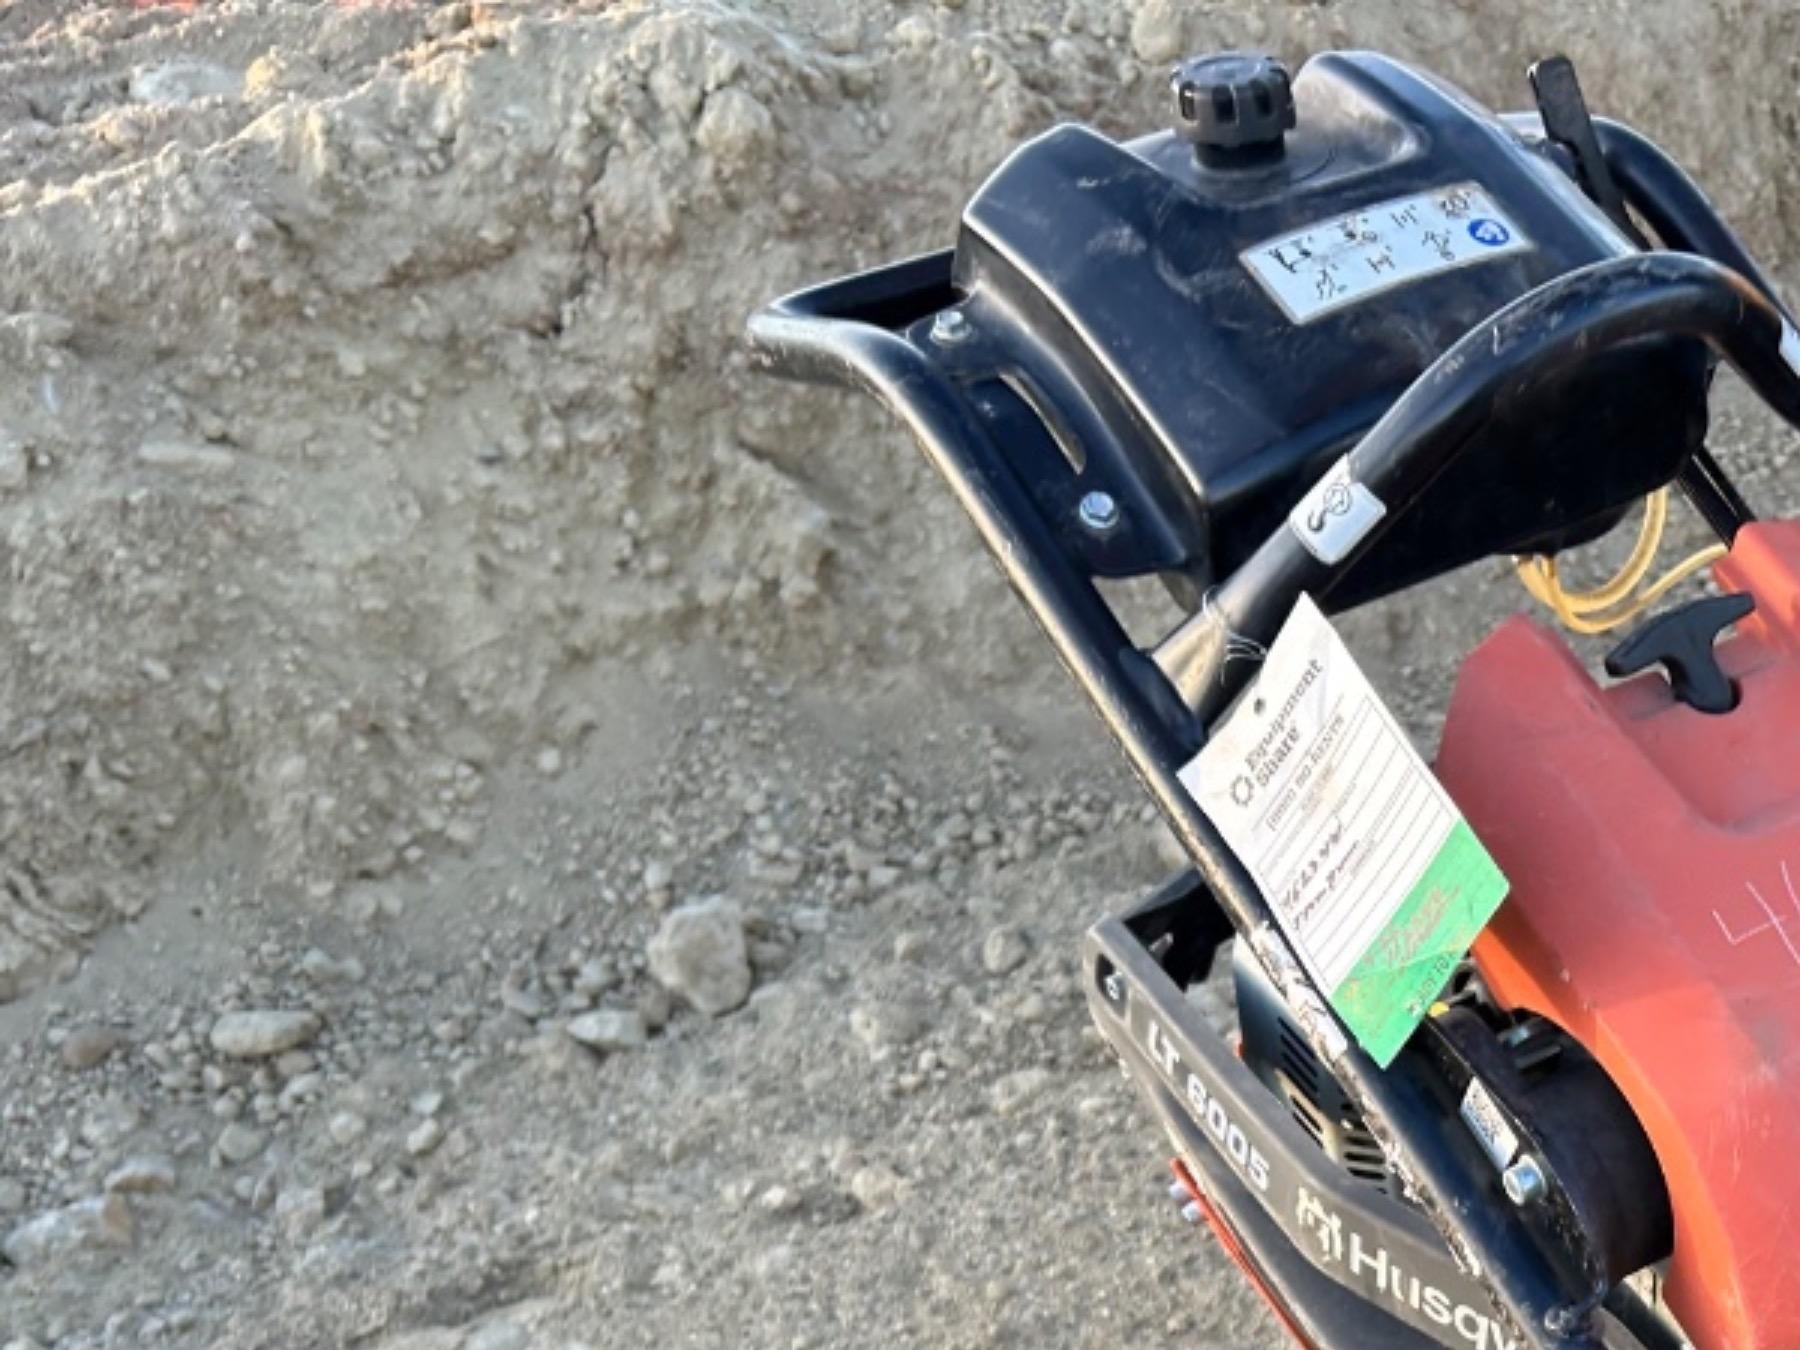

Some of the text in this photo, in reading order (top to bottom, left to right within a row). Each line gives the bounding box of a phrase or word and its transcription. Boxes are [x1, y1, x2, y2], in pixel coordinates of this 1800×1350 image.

[1243, 657, 1324, 776] Equipment
[1255, 724, 1301, 788] Share
[1146, 1022, 1180, 1077] LT
